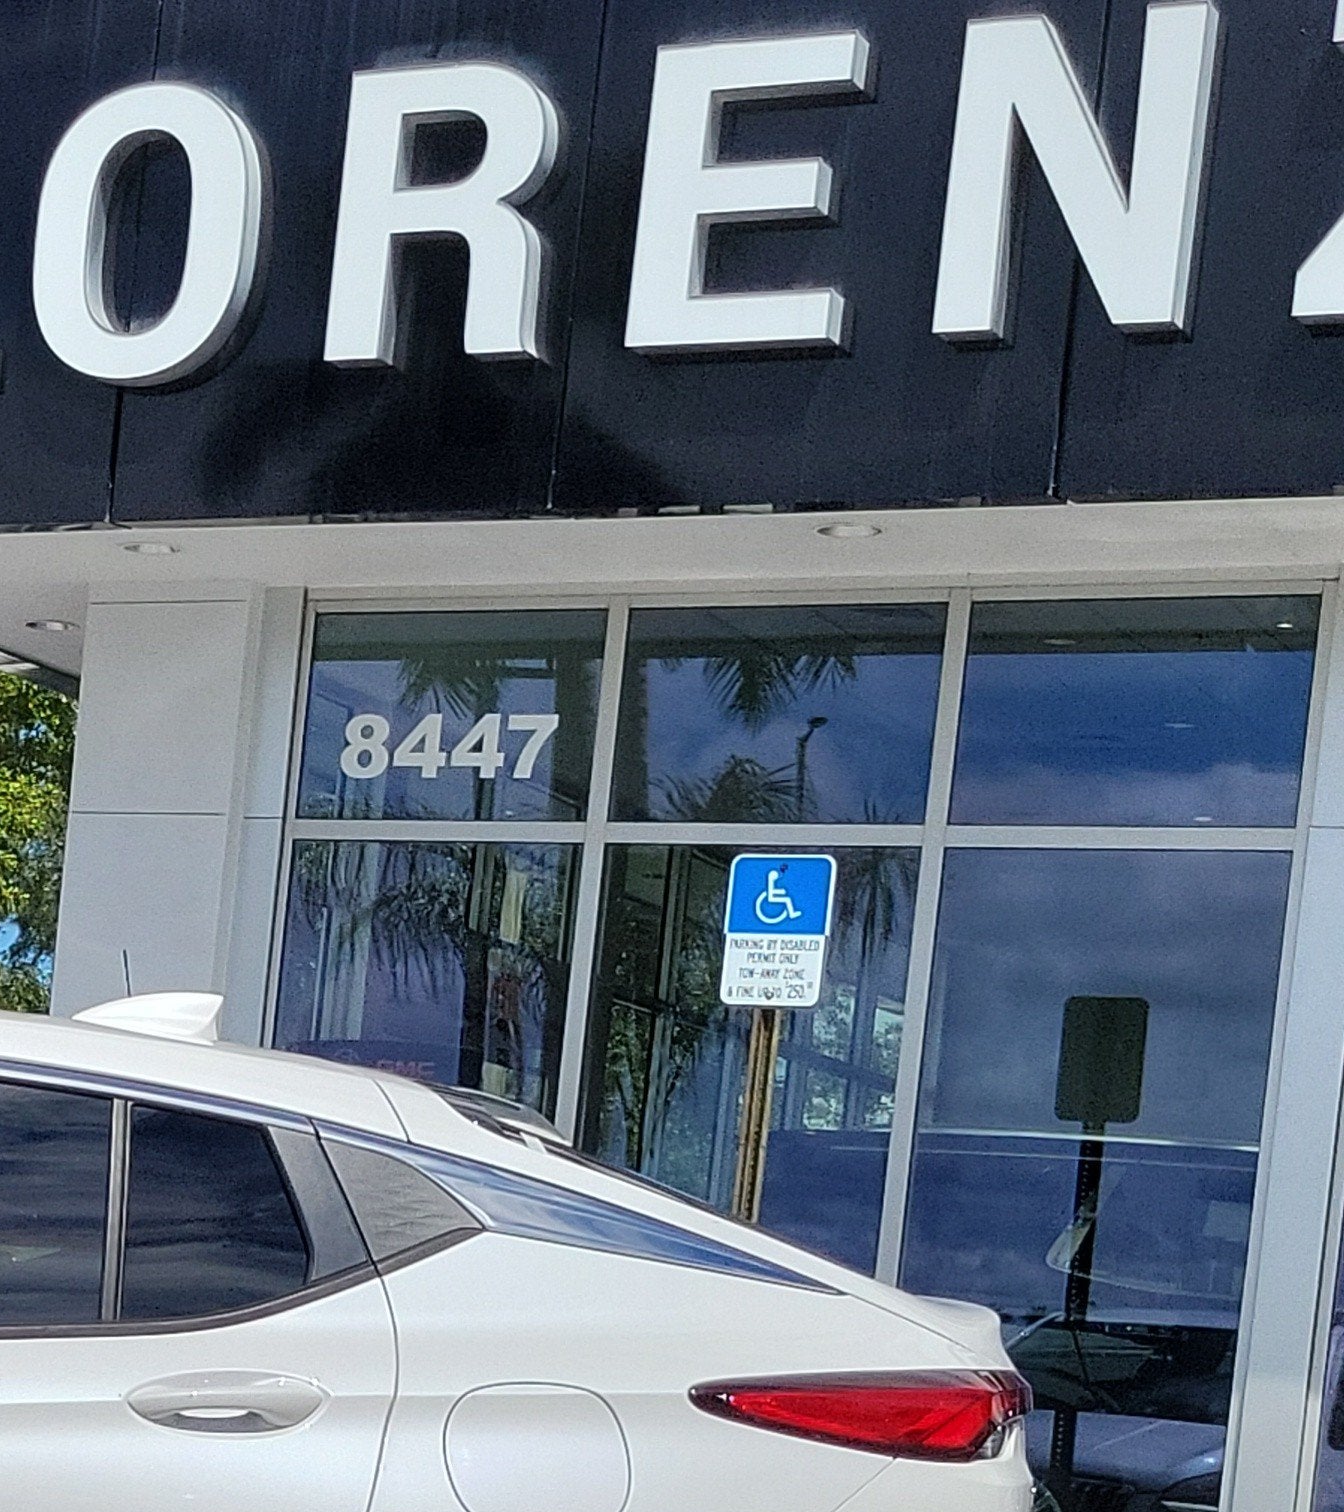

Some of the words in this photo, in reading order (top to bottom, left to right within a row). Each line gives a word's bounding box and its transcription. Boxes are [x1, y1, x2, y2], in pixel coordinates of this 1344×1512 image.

[339, 713, 560, 779] 8447
[780, 940, 820, 951] DISABLED
[747, 952, 777, 963] PERMIT
[779, 953, 799, 964] ONLY
[782, 968, 805, 980] ZONE
